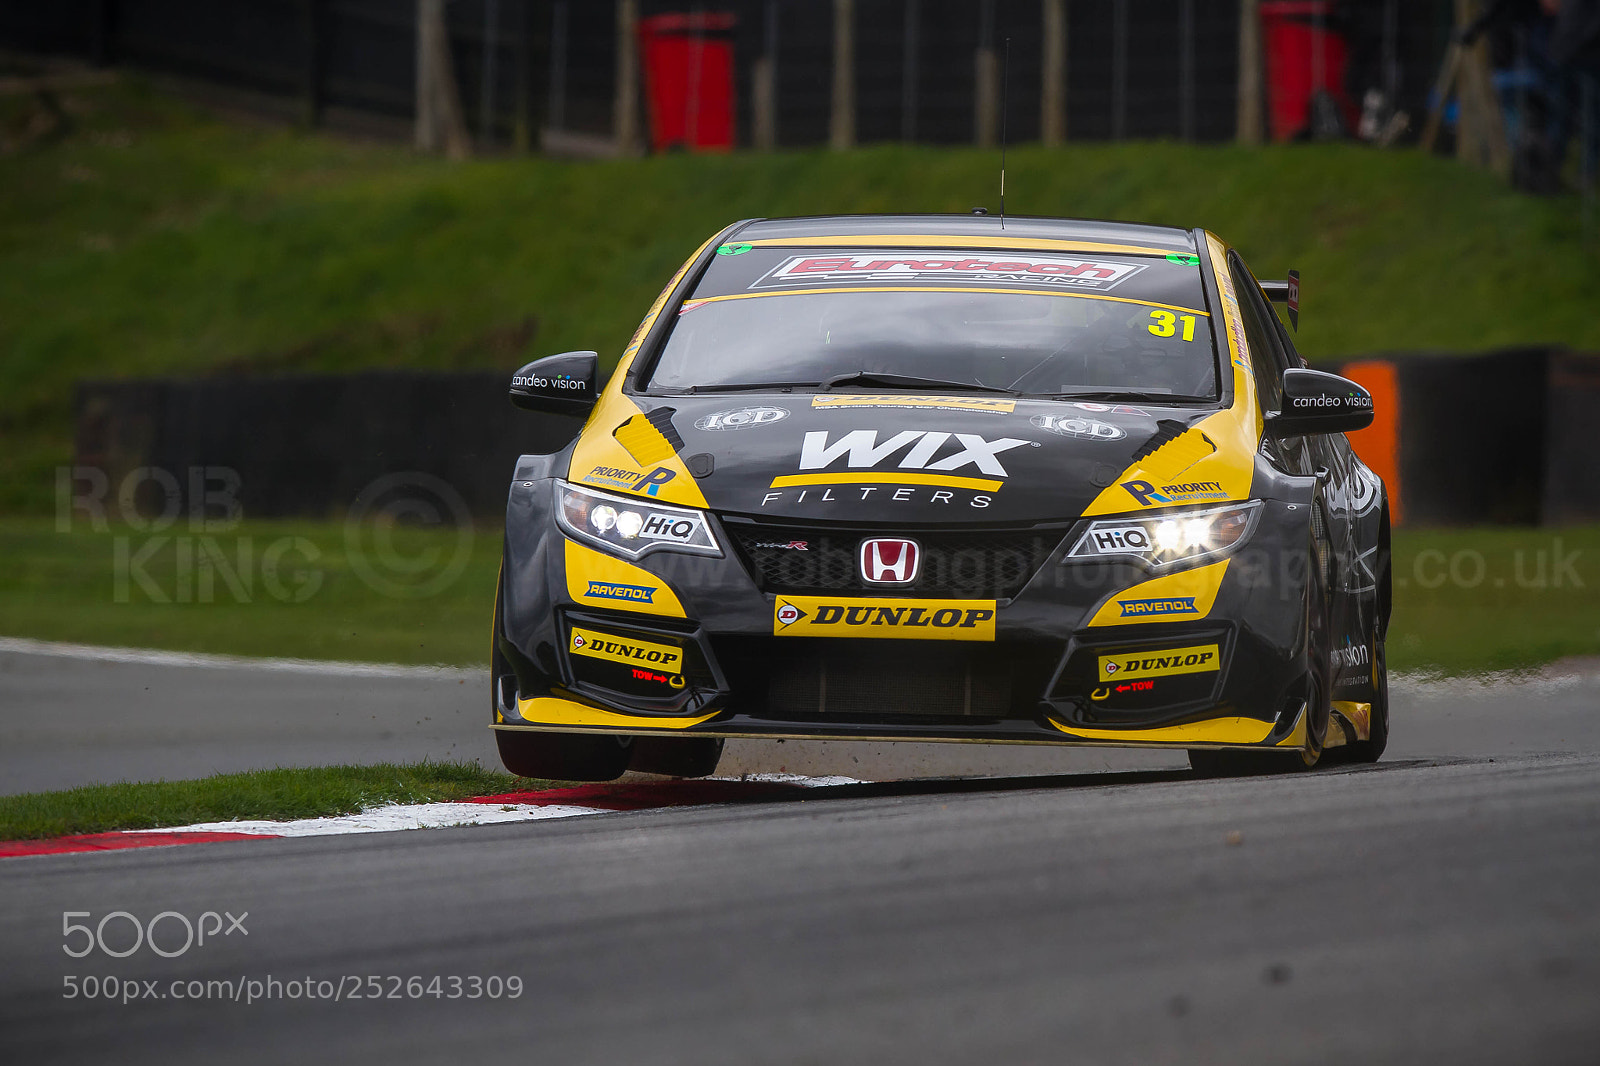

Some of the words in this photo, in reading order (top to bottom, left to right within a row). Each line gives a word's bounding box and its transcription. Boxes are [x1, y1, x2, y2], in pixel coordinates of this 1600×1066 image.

[788, 257, 1117, 278] Eurotech
[975, 273, 1103, 287] RACING
[1147, 310, 1196, 342] 31
[512, 373, 548, 388] candeo
[550, 374, 586, 390] vision
[1293, 393, 1341, 408] candeo
[1344, 392, 1373, 408] vision
[702, 409, 787, 429] ICD
[1038, 414, 1123, 439] ICD
[799, 430, 1032, 477] WIX
[581, 474, 633, 489] Recruitment
[590, 465, 646, 482] PRIORITY
[1160, 481, 1222, 495] PRIORITY
[1169, 491, 1231, 502] Recruitment
[761, 486, 992, 509] FILTERS
[643, 516, 694, 538] HiQ
[1094, 530, 1149, 548] HiQ
[590, 584, 650, 600] RAVENOL
[1124, 600, 1193, 614] RAVENOL
[810, 605, 994, 628] DUNLOP
[588, 639, 678, 664] DUNLOP
[1123, 652, 1213, 672] DUNLOP
[632, 668, 654, 681] TOW
[1131, 680, 1154, 691] TOW
